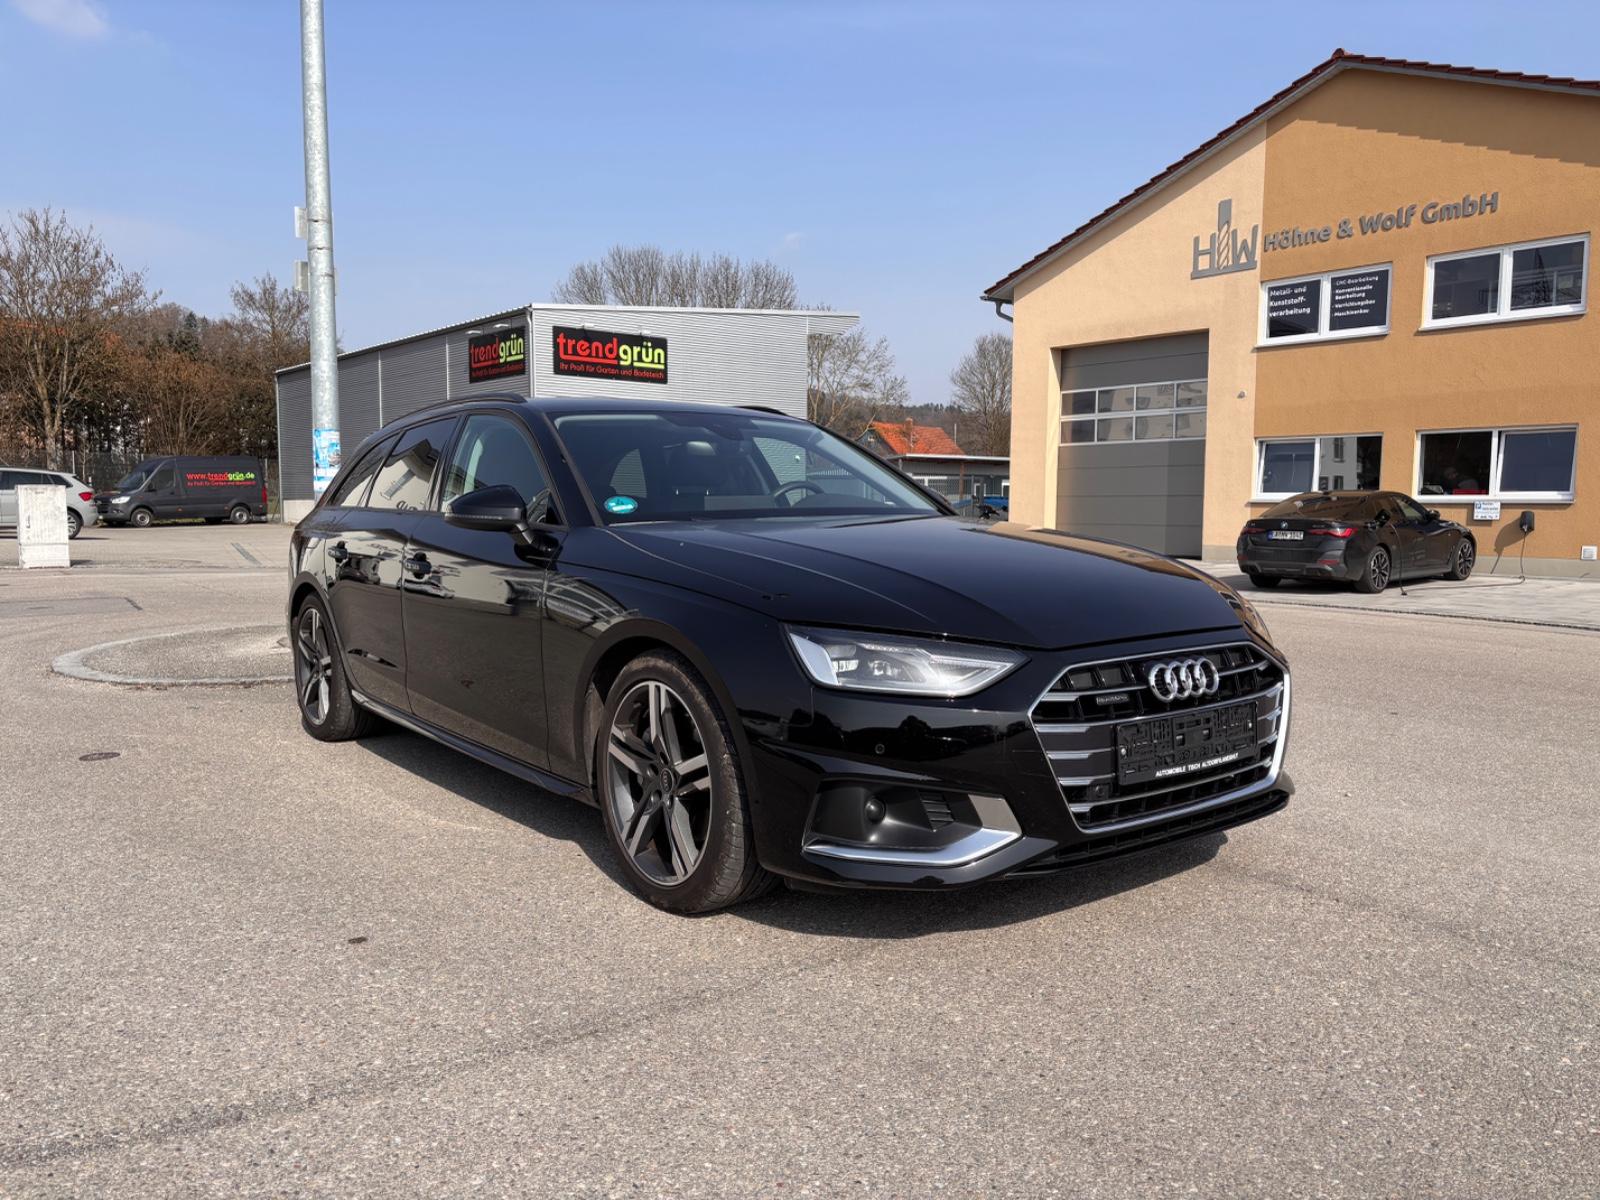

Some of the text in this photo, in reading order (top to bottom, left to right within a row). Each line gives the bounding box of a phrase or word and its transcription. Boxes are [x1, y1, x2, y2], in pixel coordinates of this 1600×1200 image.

[1264, 191, 1499, 252] Höhne & Wolf GmbH
[1294, 286, 1307, 294] und
[1269, 307, 1311, 317] verarbeitung
[471, 333, 524, 368] trendgrün
[557, 332, 665, 369] trendgrün
[596, 366, 618, 374] Garten
[1155, 765, 1186, 778] AUTOMOBILE
